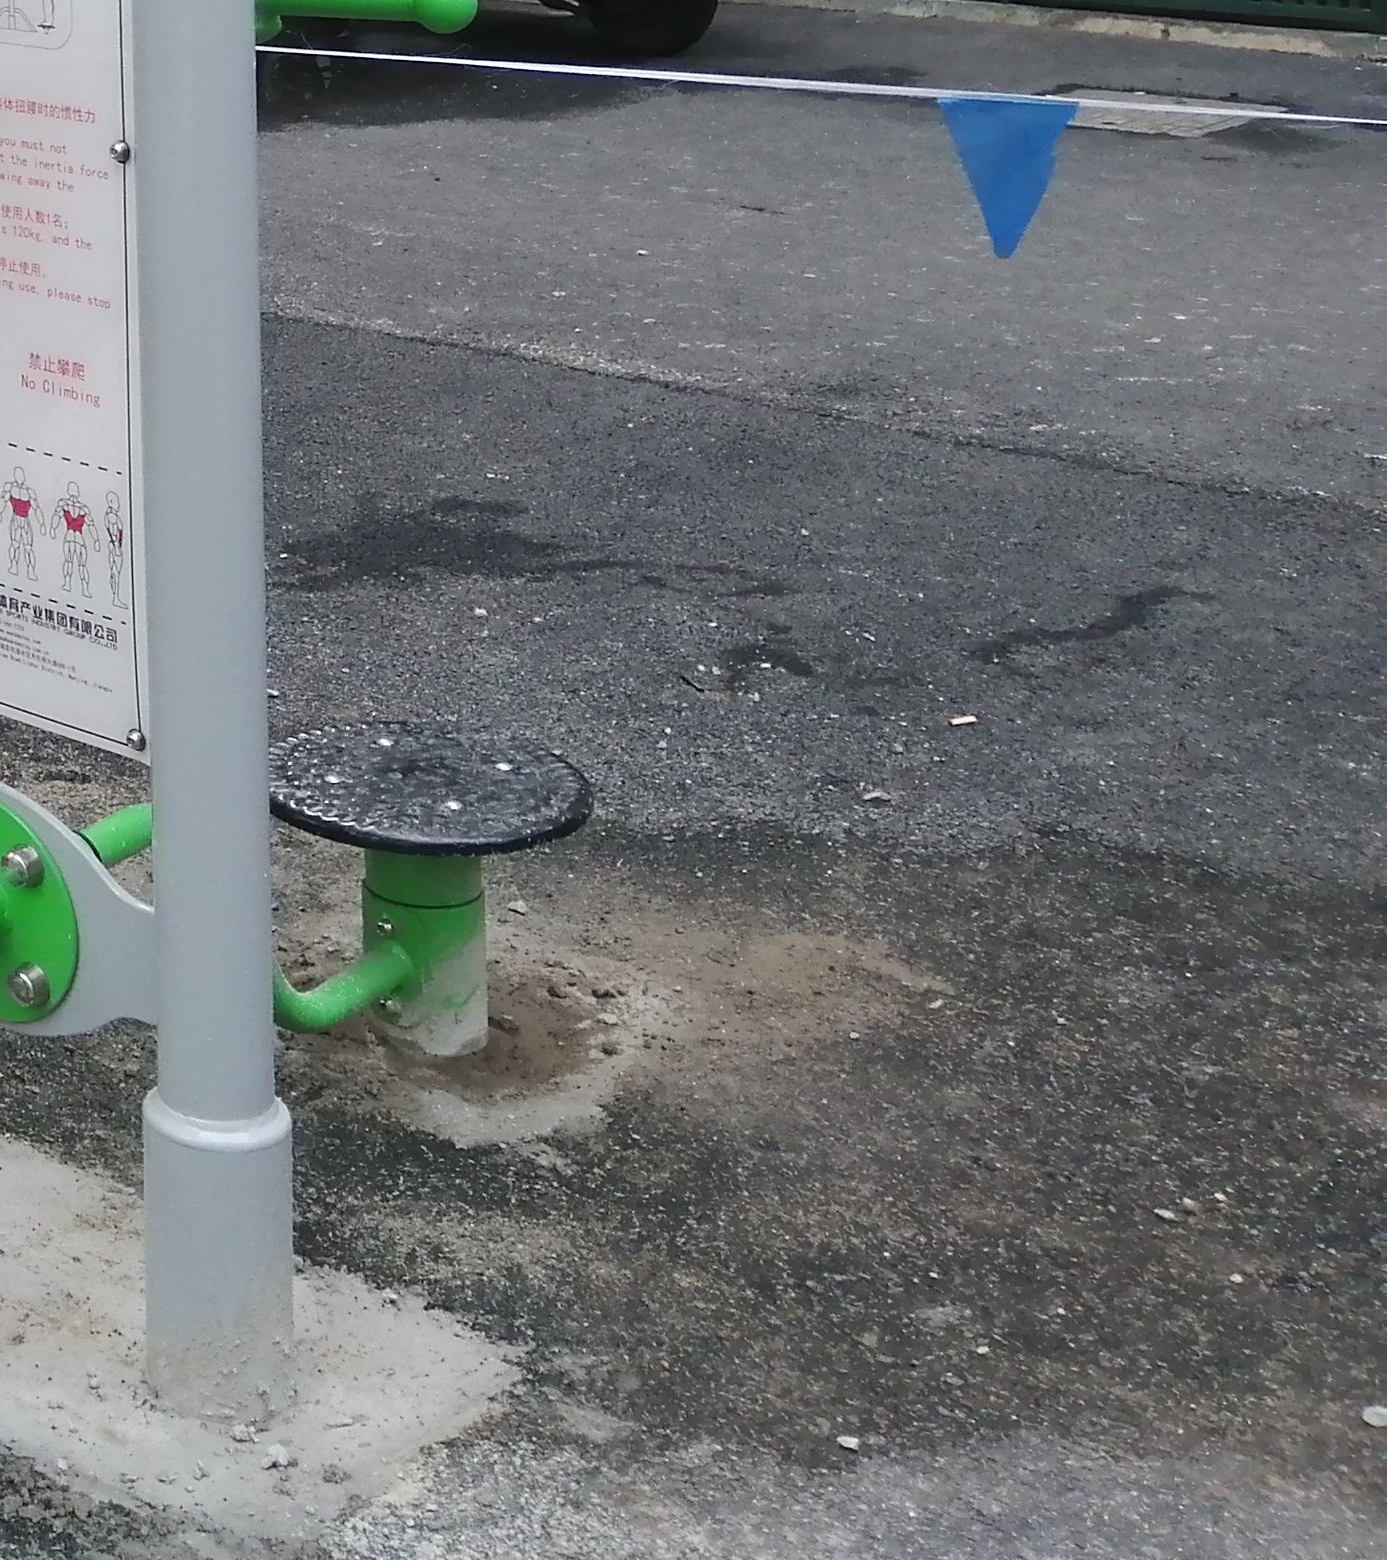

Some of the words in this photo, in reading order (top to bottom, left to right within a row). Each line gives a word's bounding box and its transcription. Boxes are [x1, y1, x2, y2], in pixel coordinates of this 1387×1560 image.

[0, 136, 16, 148] you
[21, 139, 44, 151] must
[50, 144, 68, 155] not
[11, 154, 28, 166] the
[35, 157, 74, 174] inertia
[80, 164, 109, 179] force
[28, 176, 51, 189] away
[57, 180, 74, 192] the
[52, 234, 69, 246] and
[75, 238, 93, 251] the
[47, 288, 82, 303] please
[88, 296, 111, 310] stop
[28, 352, 86, 382] 禁止攀爬
[21, 374, 36, 390] No
[42, 379, 101, 408] Climbing
[6, 610, 28, 622] SPORTS
[64, 629, 86, 639] GROUP
